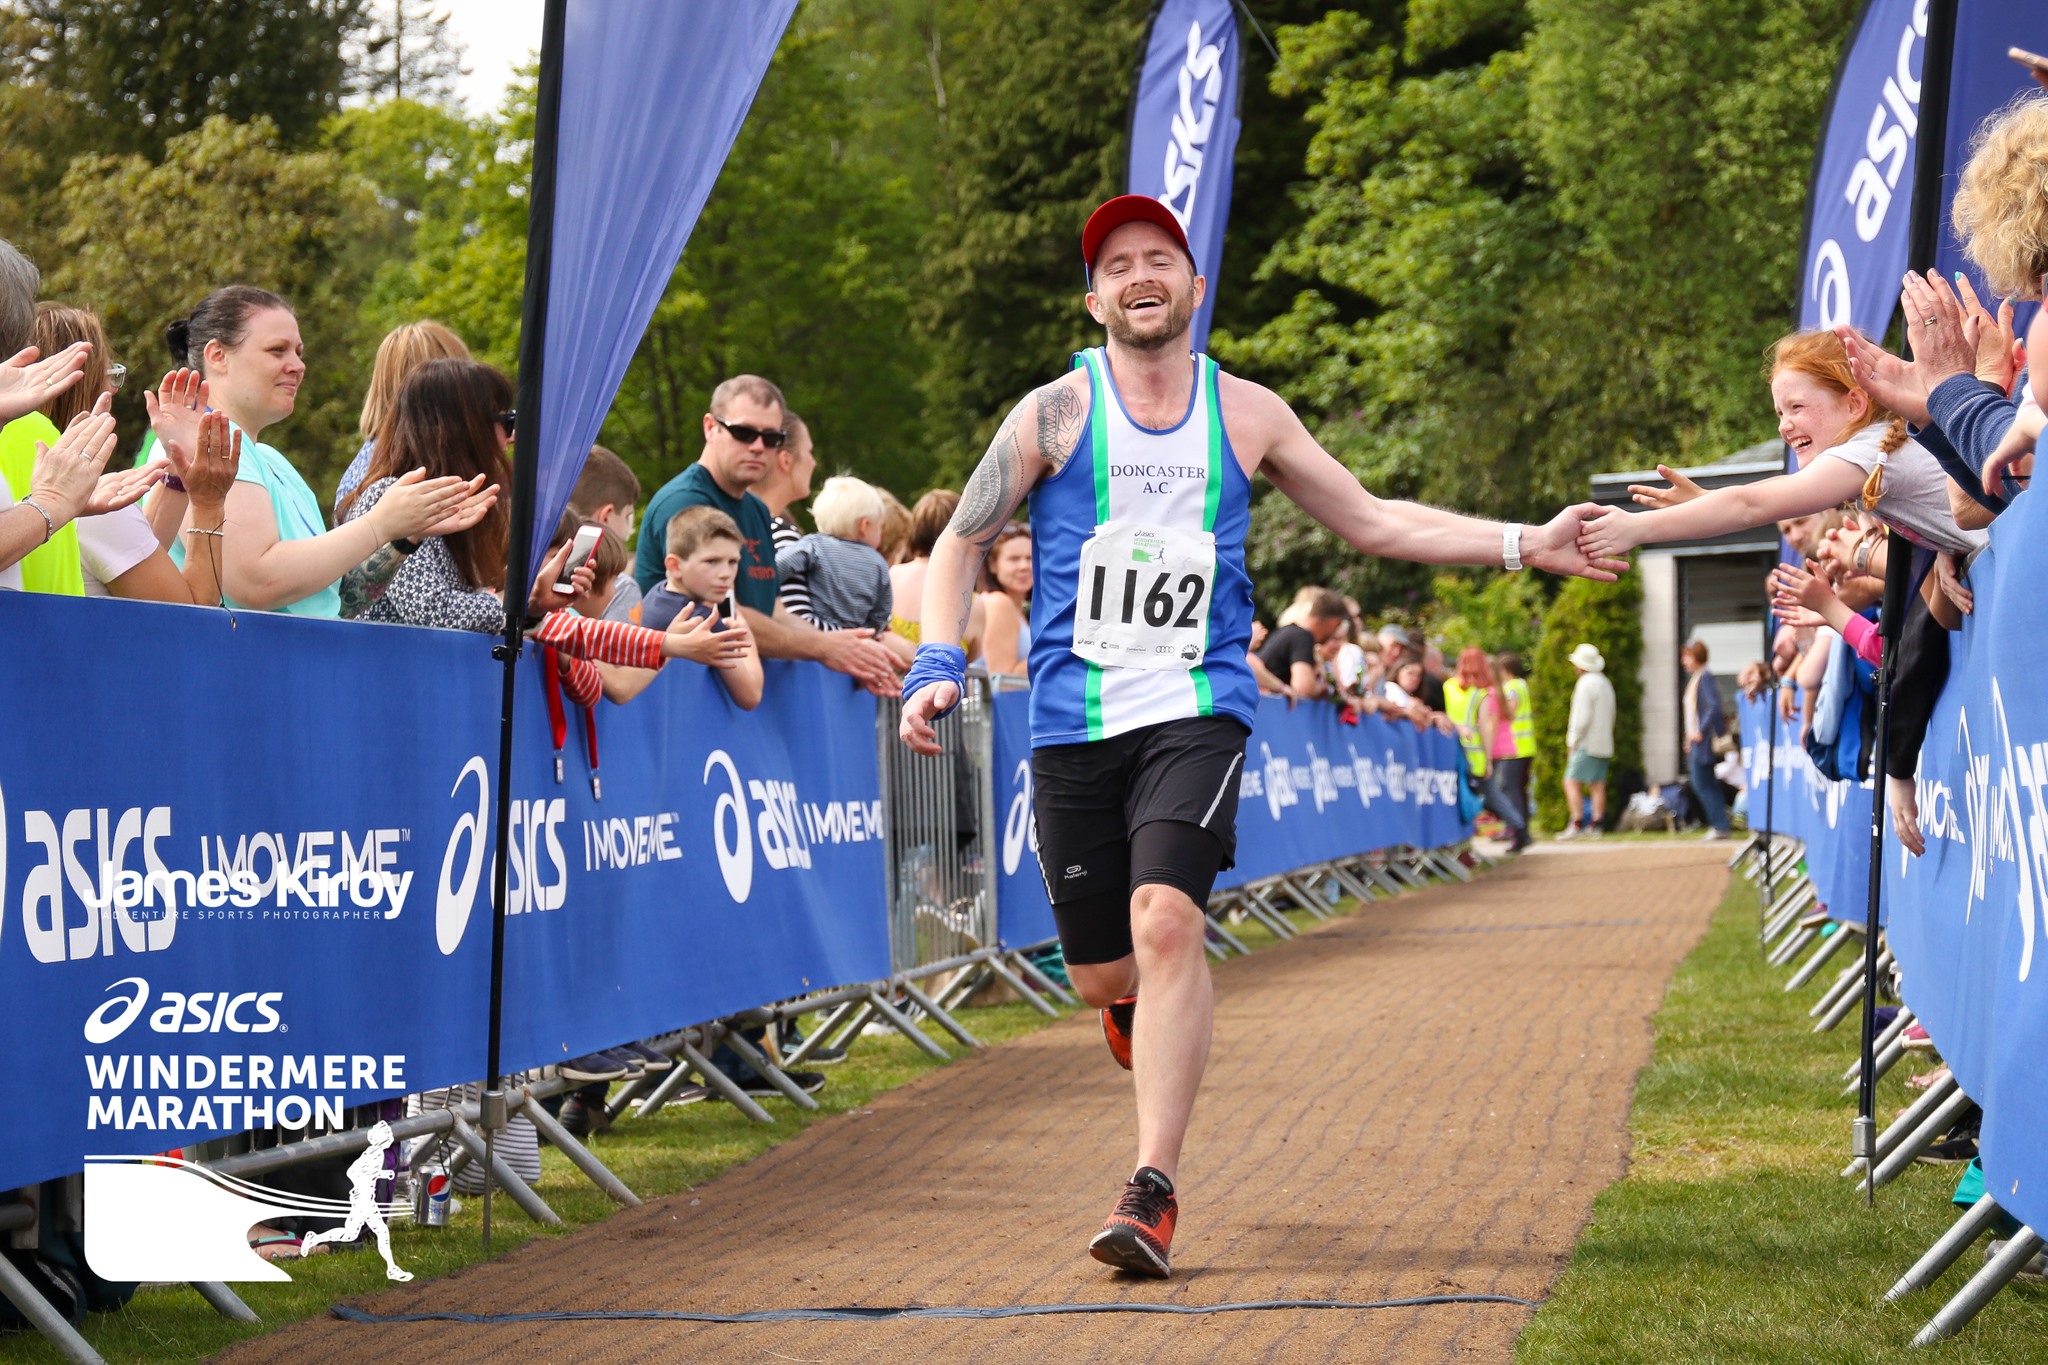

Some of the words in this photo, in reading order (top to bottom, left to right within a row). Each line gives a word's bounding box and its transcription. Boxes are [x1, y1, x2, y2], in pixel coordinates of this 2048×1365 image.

[1110, 464, 1206, 479] DONCASTER
[1142, 482, 1173, 494] A.C.
[1090, 565, 1205, 628] 1162
[591, 816, 650, 869] MOVE
